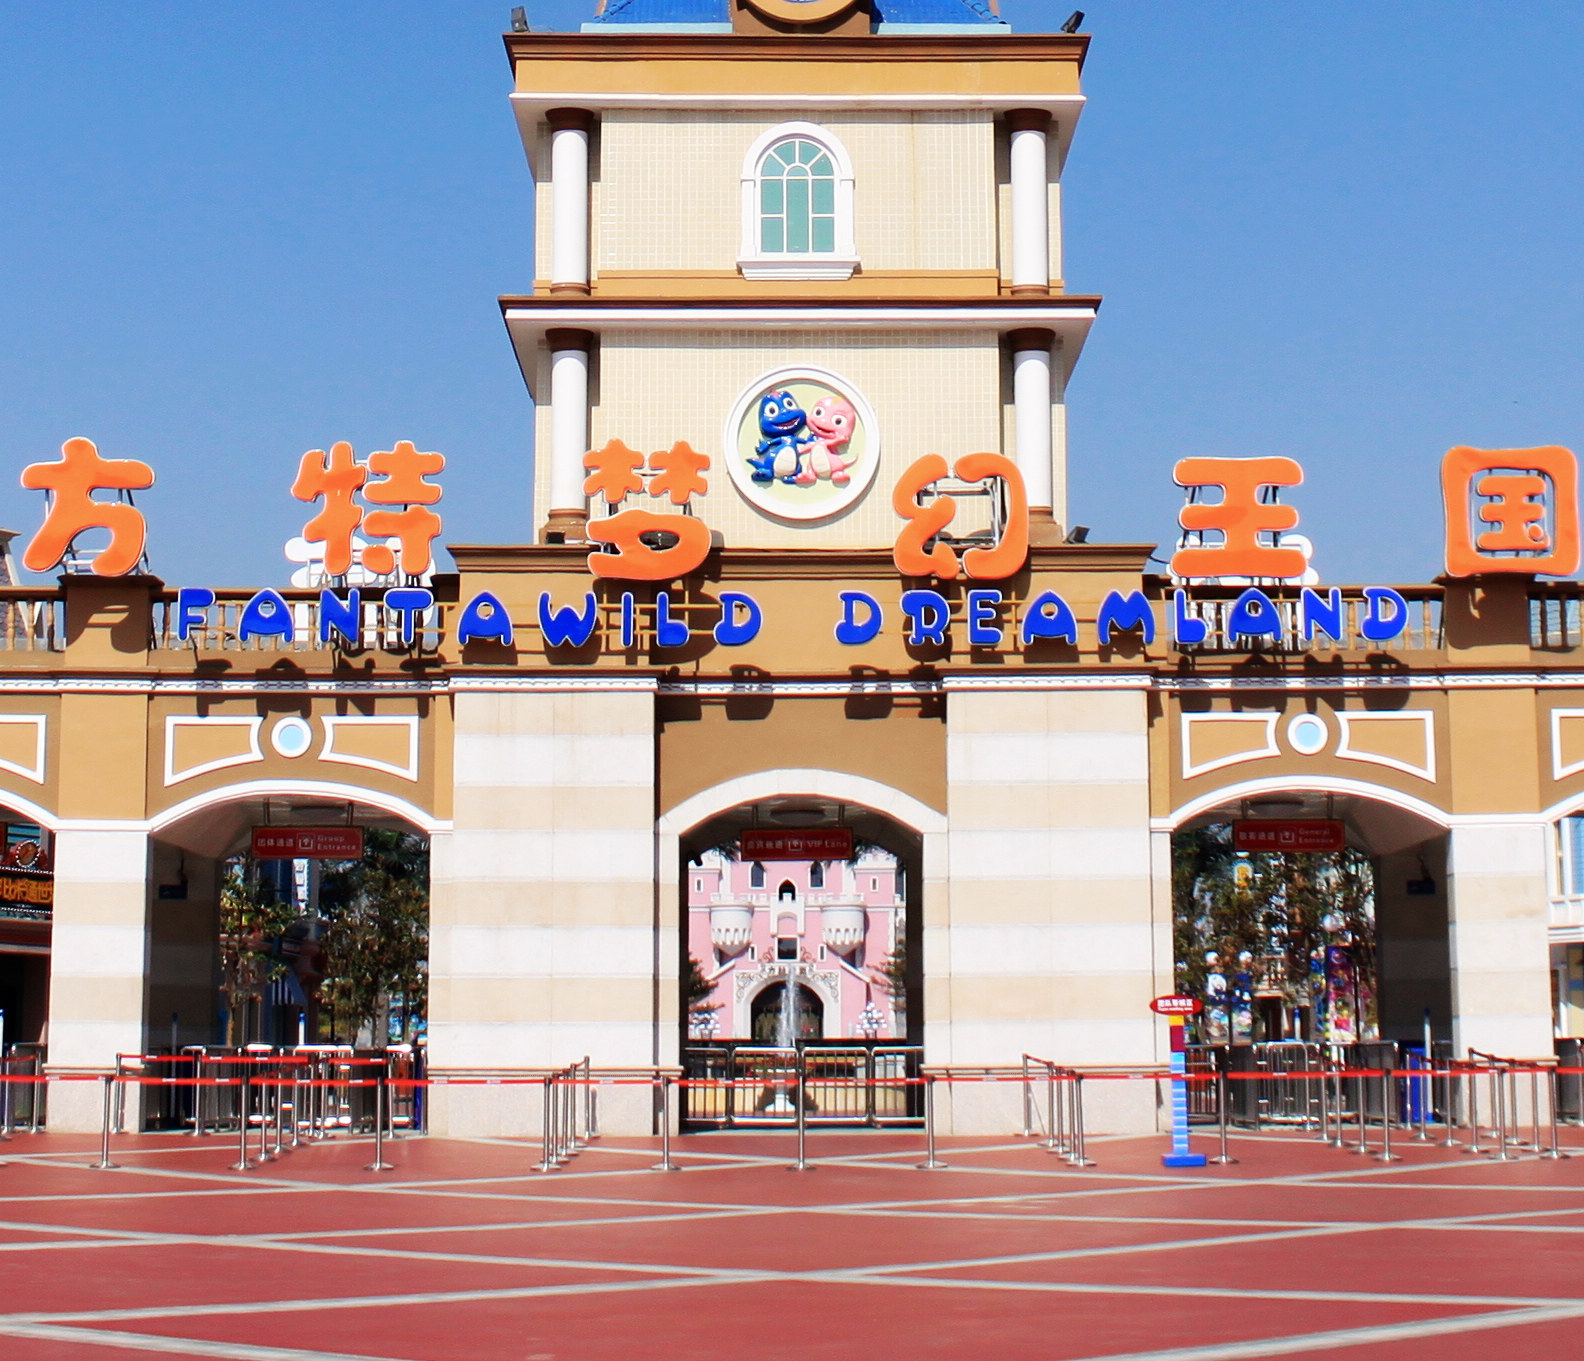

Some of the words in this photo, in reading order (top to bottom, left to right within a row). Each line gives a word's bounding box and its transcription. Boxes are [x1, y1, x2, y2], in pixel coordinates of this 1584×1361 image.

[19, 436, 1581, 581] 方特梦幻王国
[835, 585, 1409, 647] DREAMLAND
